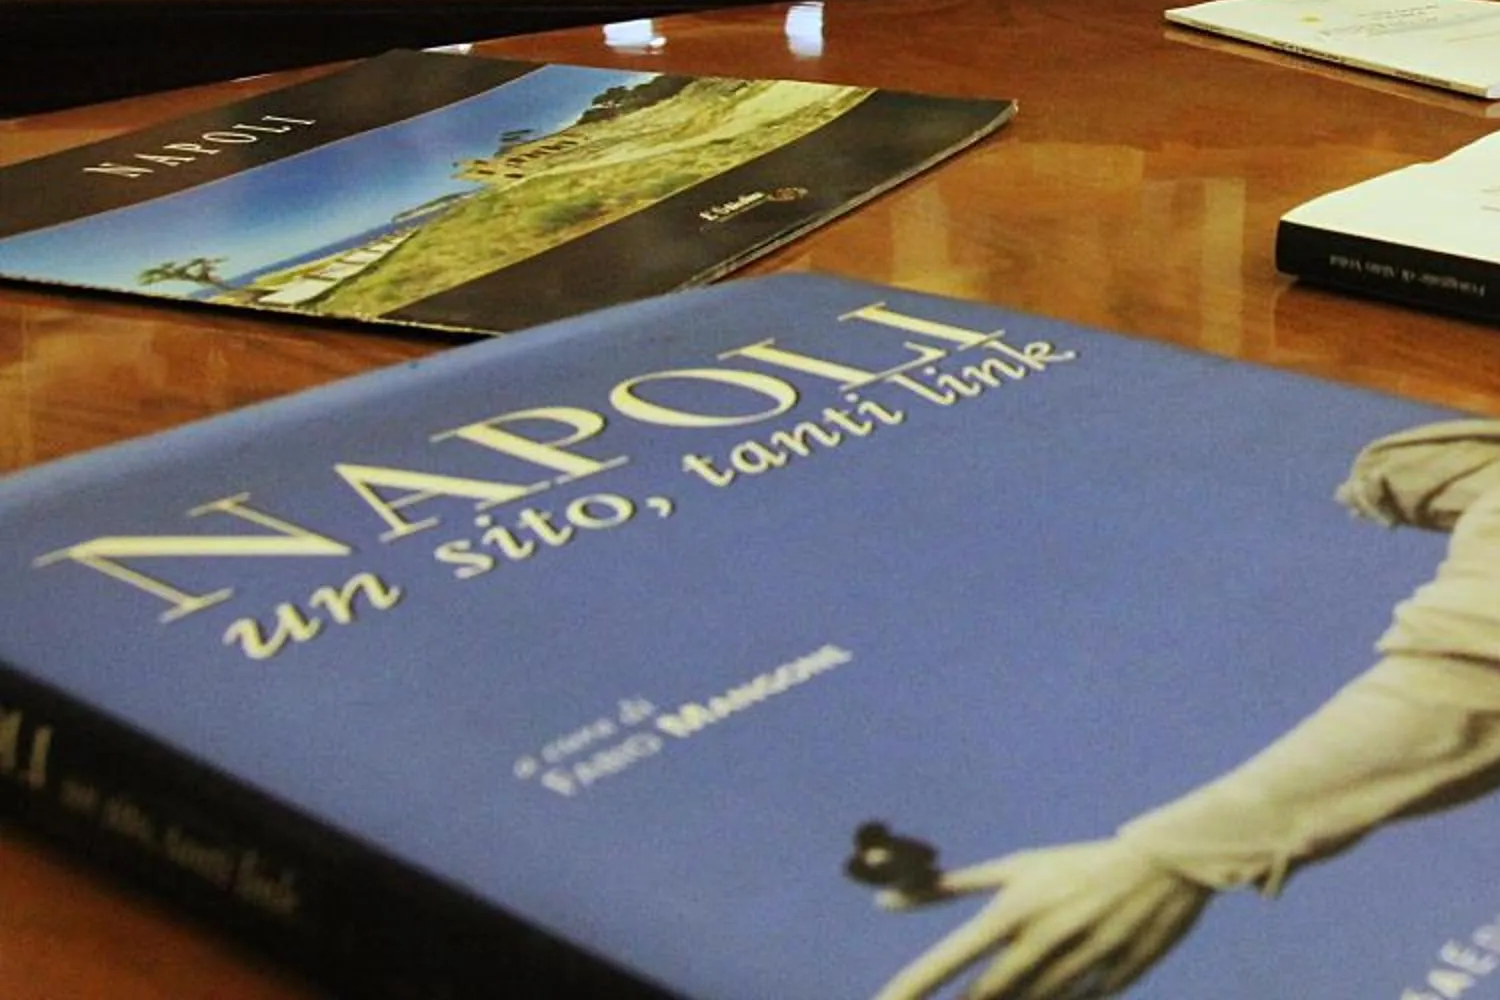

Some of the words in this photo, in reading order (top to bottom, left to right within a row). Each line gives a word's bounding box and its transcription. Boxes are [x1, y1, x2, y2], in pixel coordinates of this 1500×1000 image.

[84, 113, 317, 180] NAPOLI
[32, 300, 1006, 624] NAPOLI
[221, 570, 402, 663] un
[434, 490, 676, 578] sito,
[681, 392, 902, 492] tanti
[904, 332, 1078, 407] link
